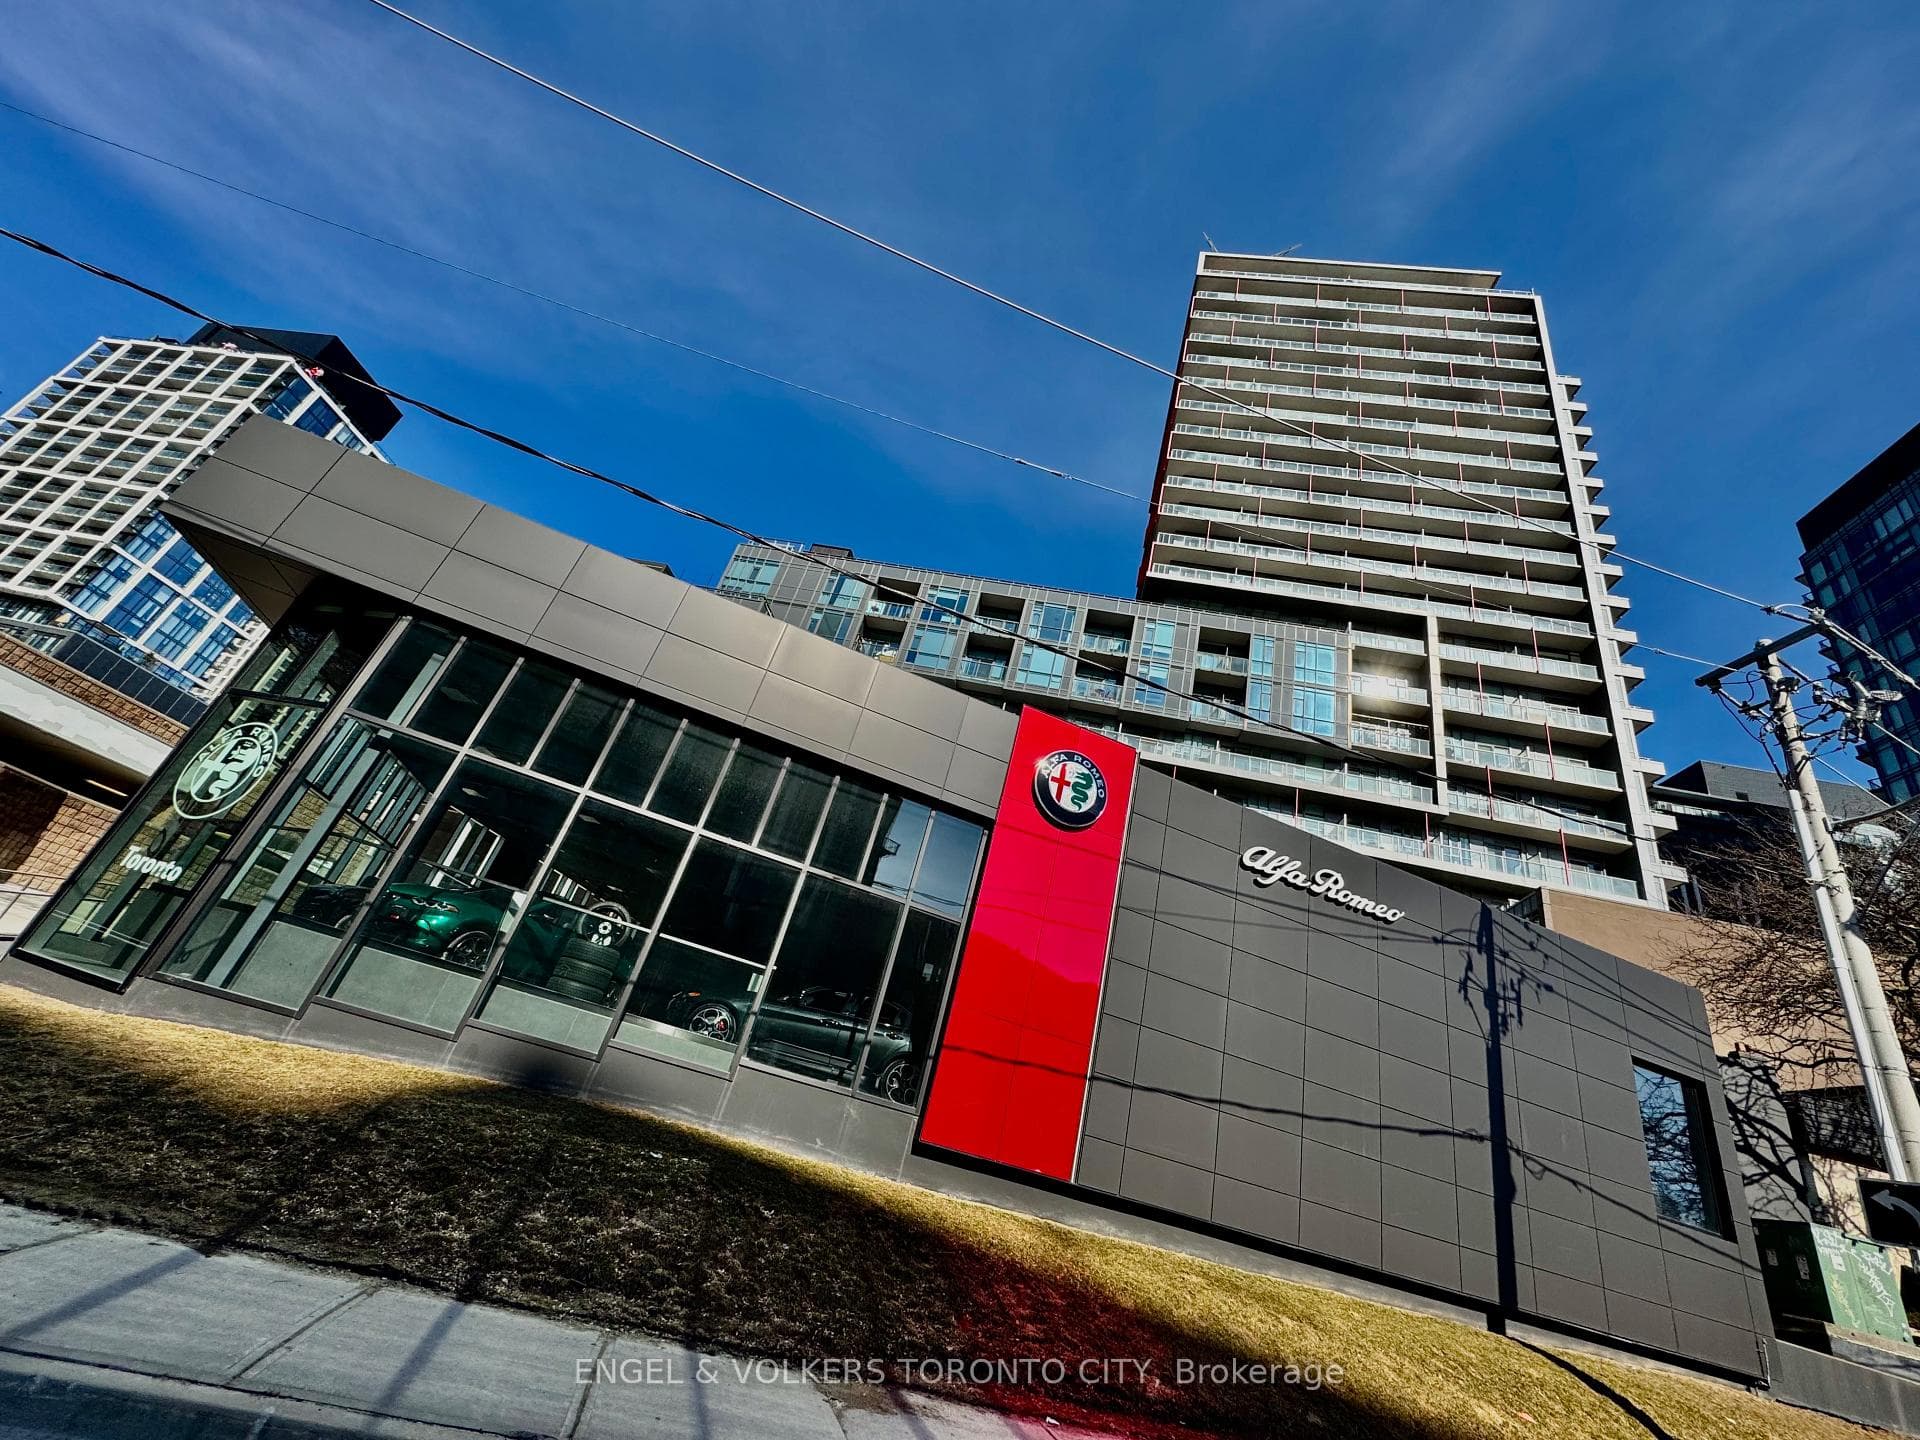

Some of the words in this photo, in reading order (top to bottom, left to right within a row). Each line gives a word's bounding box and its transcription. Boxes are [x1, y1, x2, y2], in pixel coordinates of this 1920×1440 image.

[198, 729, 243, 762] ALFA
[250, 726, 272, 778] ROMEO
[1041, 754, 1069, 778] ALFA
[1074, 754, 1105, 798] ROMEO
[120, 844, 183, 881] Toronto
[1242, 846, 1311, 885] Alfa
[1310, 868, 1405, 922] Romeo
